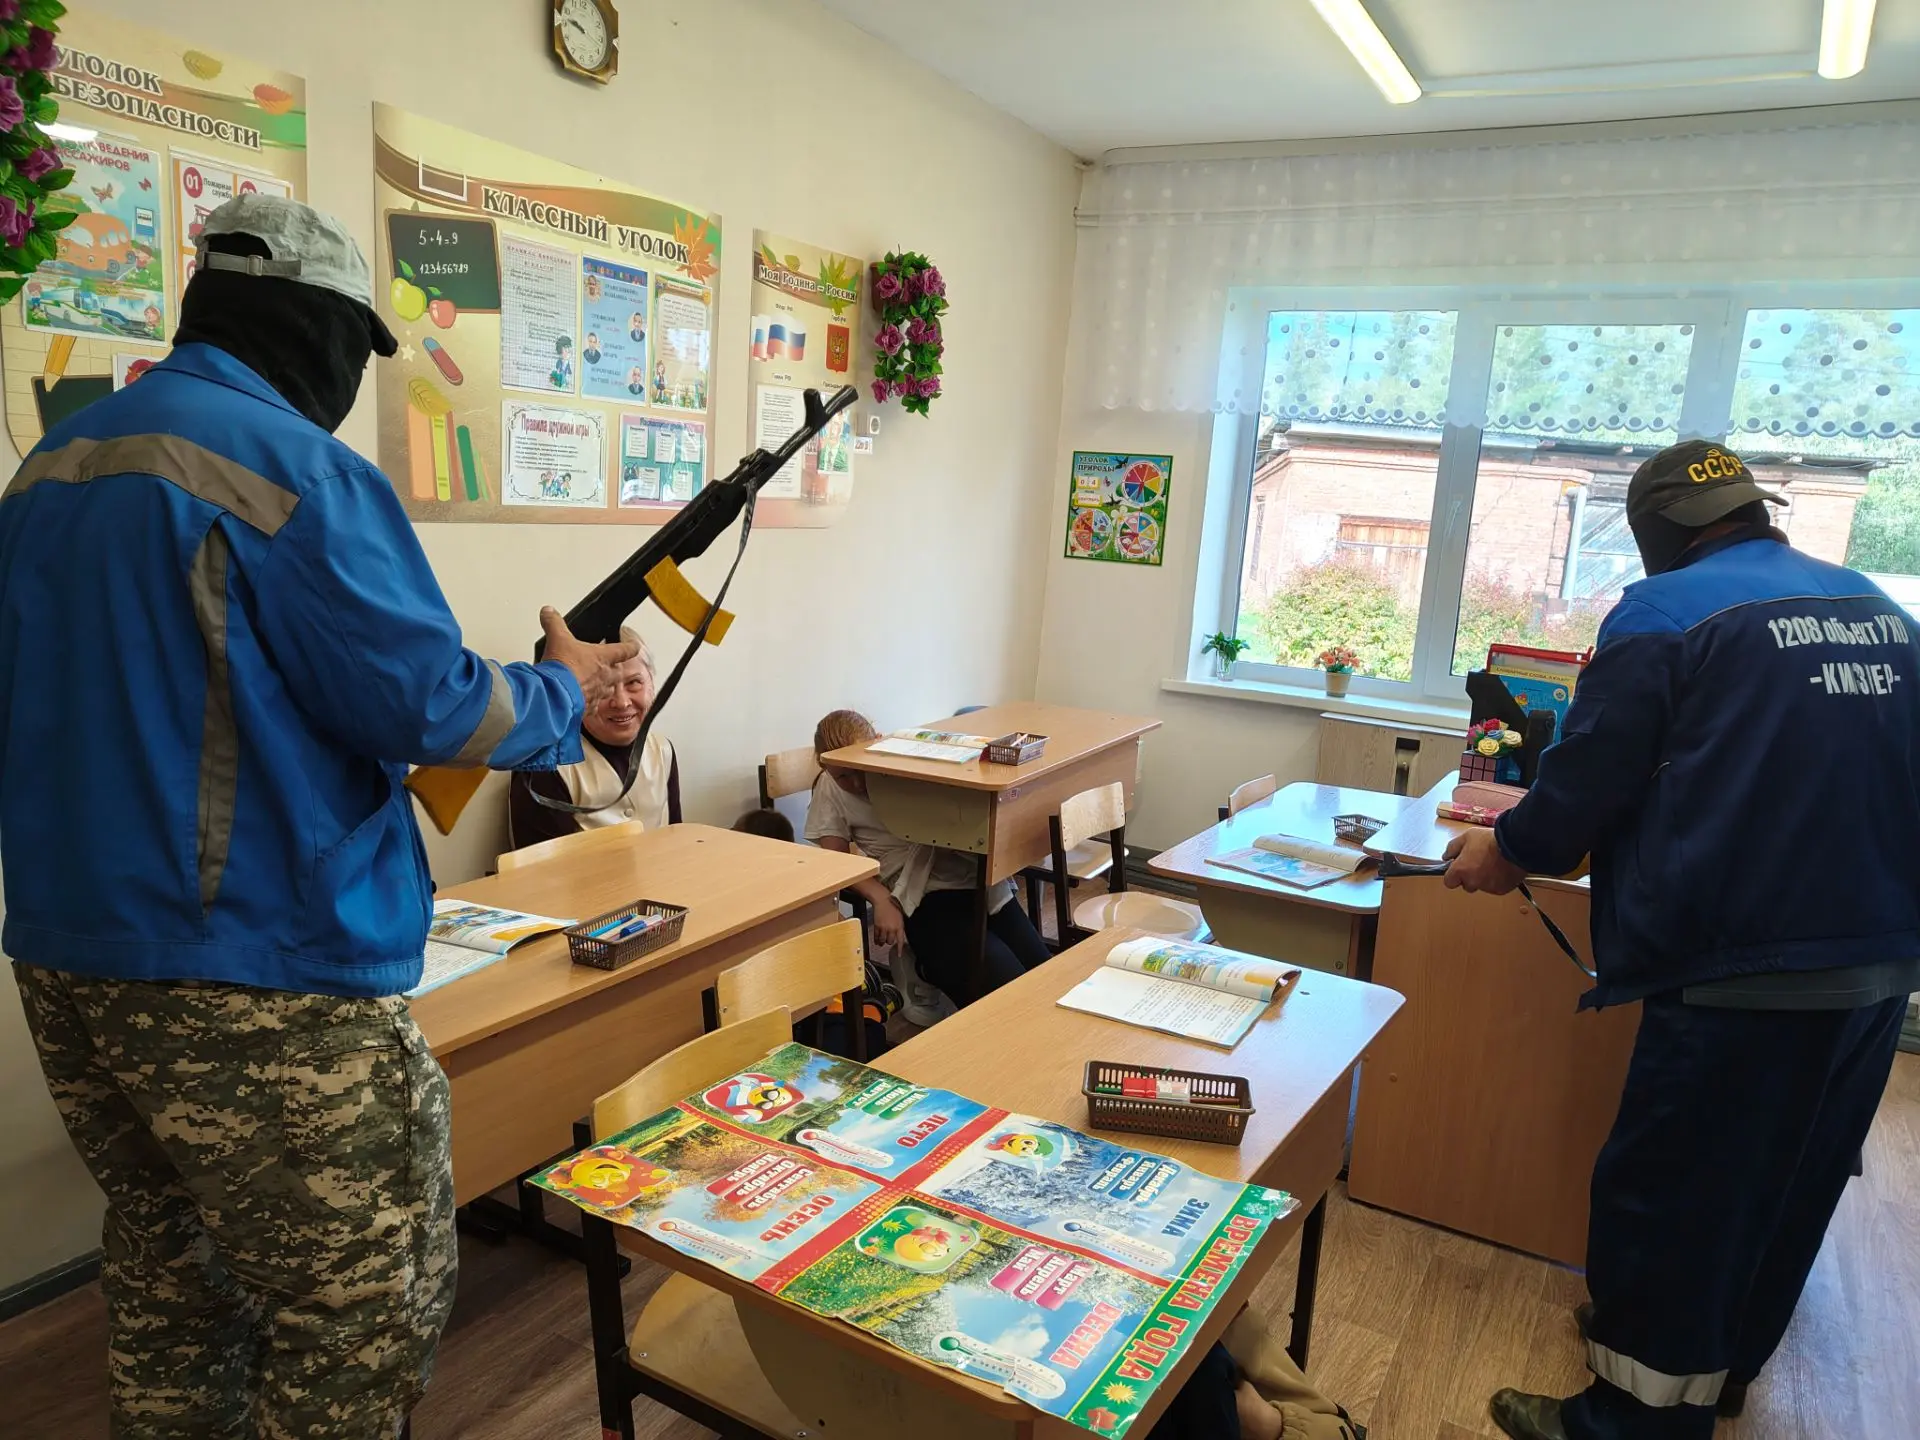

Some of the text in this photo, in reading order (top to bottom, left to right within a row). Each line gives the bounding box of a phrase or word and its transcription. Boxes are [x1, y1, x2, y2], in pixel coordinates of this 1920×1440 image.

[56, 46, 163, 95] УГОЛОК
[53, 74, 260, 149] БЕЗОПАСНОСТИ
[186, 174, 199, 191] 01
[482, 187, 608, 242] КЛАССНЫЙ
[617, 227, 690, 264] УГОЛОК
[419, 261, 469, 275] 123456789
[760, 265, 780, 282] Моя
[783, 271, 816, 291] Родина
[827, 283, 856, 301] Россия
[521, 412, 548, 435] Правила
[1687, 455, 1743, 482] СССР
[1768, 615, 1824, 648] 1208
[853, 1081, 892, 1106] Август
[896, 1114, 949, 1148] ЛЕТО
[727, 1153, 779, 1182] Ноябрь
[736, 1159, 796, 1196] Октябрь
[1092, 1156, 1135, 1190] Февраль
[1119, 1160, 1157, 1191] Январь
[1135, 1163, 1178, 1202] Декабрь
[747, 1168, 814, 1208] Сентябрь
[759, 1194, 836, 1242] ОСЕНЬ
[1161, 1197, 1210, 1238] ЗИМА
[1012, 1248, 1044, 1272] Май
[1019, 1255, 1067, 1296] Апрель
[1053, 1264, 1092, 1296] Март
[1116, 1214, 1262, 1381] ВРЕМЕНА ГОДА
[1050, 1301, 1124, 1369] ВЕСНА
